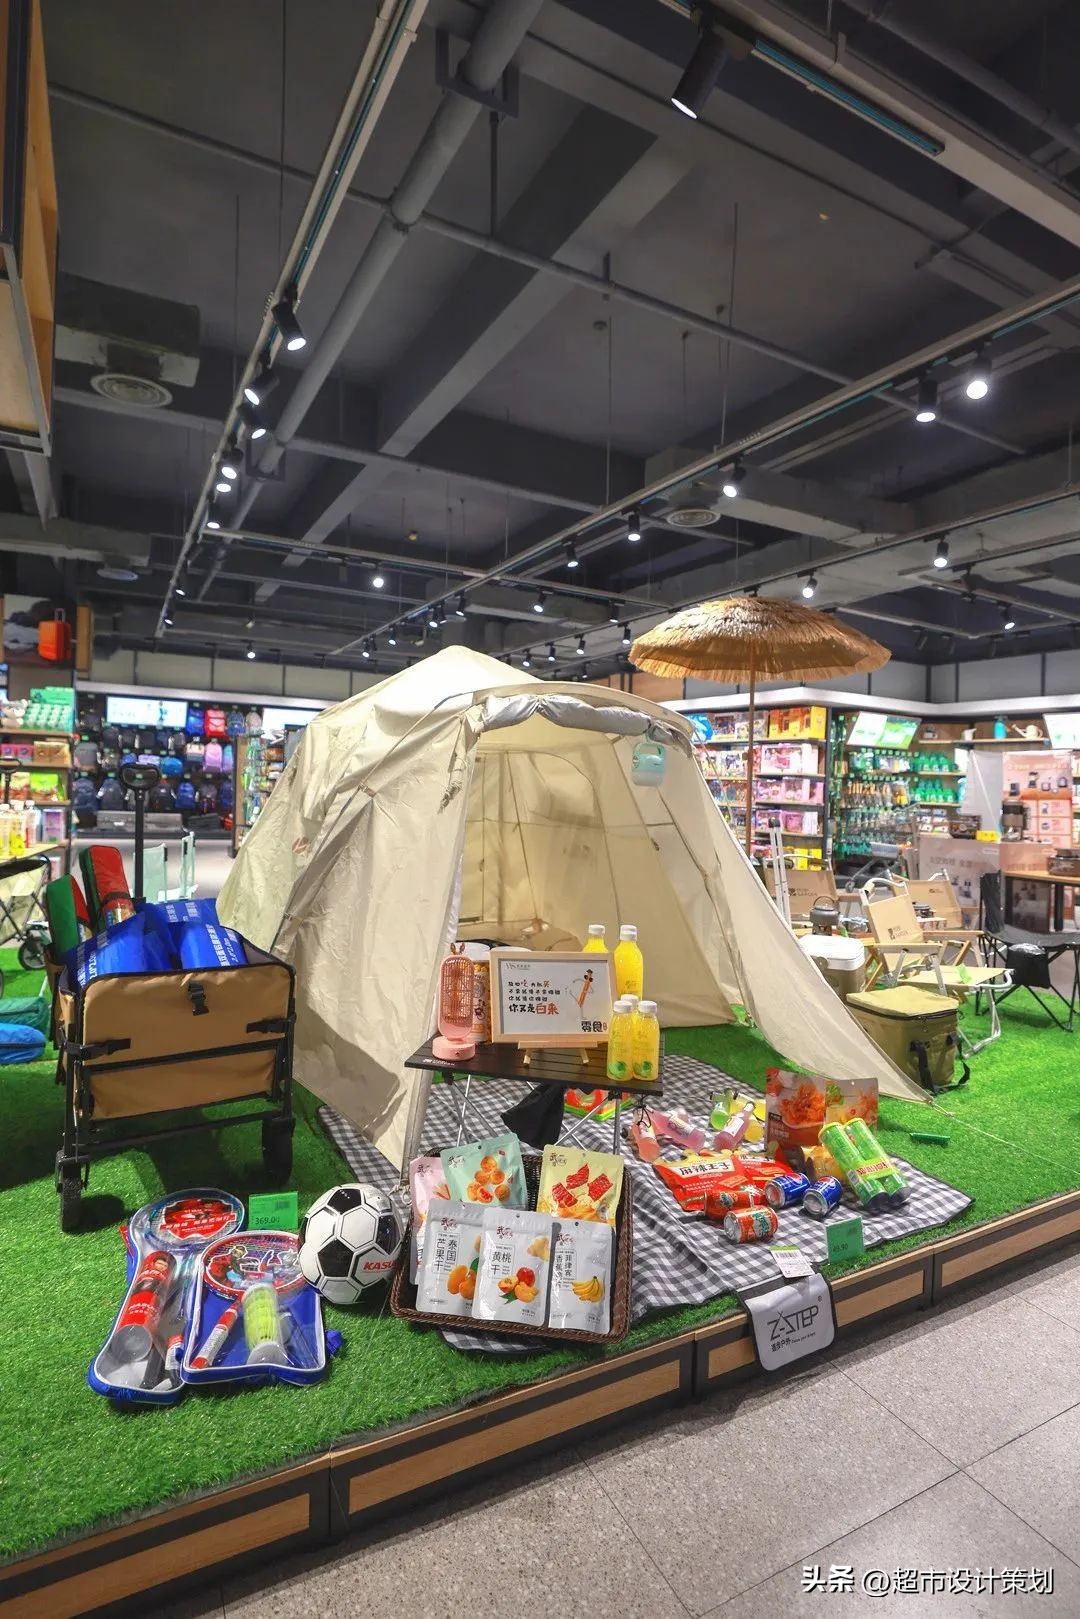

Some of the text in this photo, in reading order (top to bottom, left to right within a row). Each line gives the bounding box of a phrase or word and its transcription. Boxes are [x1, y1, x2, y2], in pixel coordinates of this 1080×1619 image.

[509, 1003, 559, 1015] 你又是白来
[680, 1161, 731, 1176] 麻辣王子
[434, 1238, 446, 1271] 芒果干
[447, 1239, 458, 1261] 泰国
